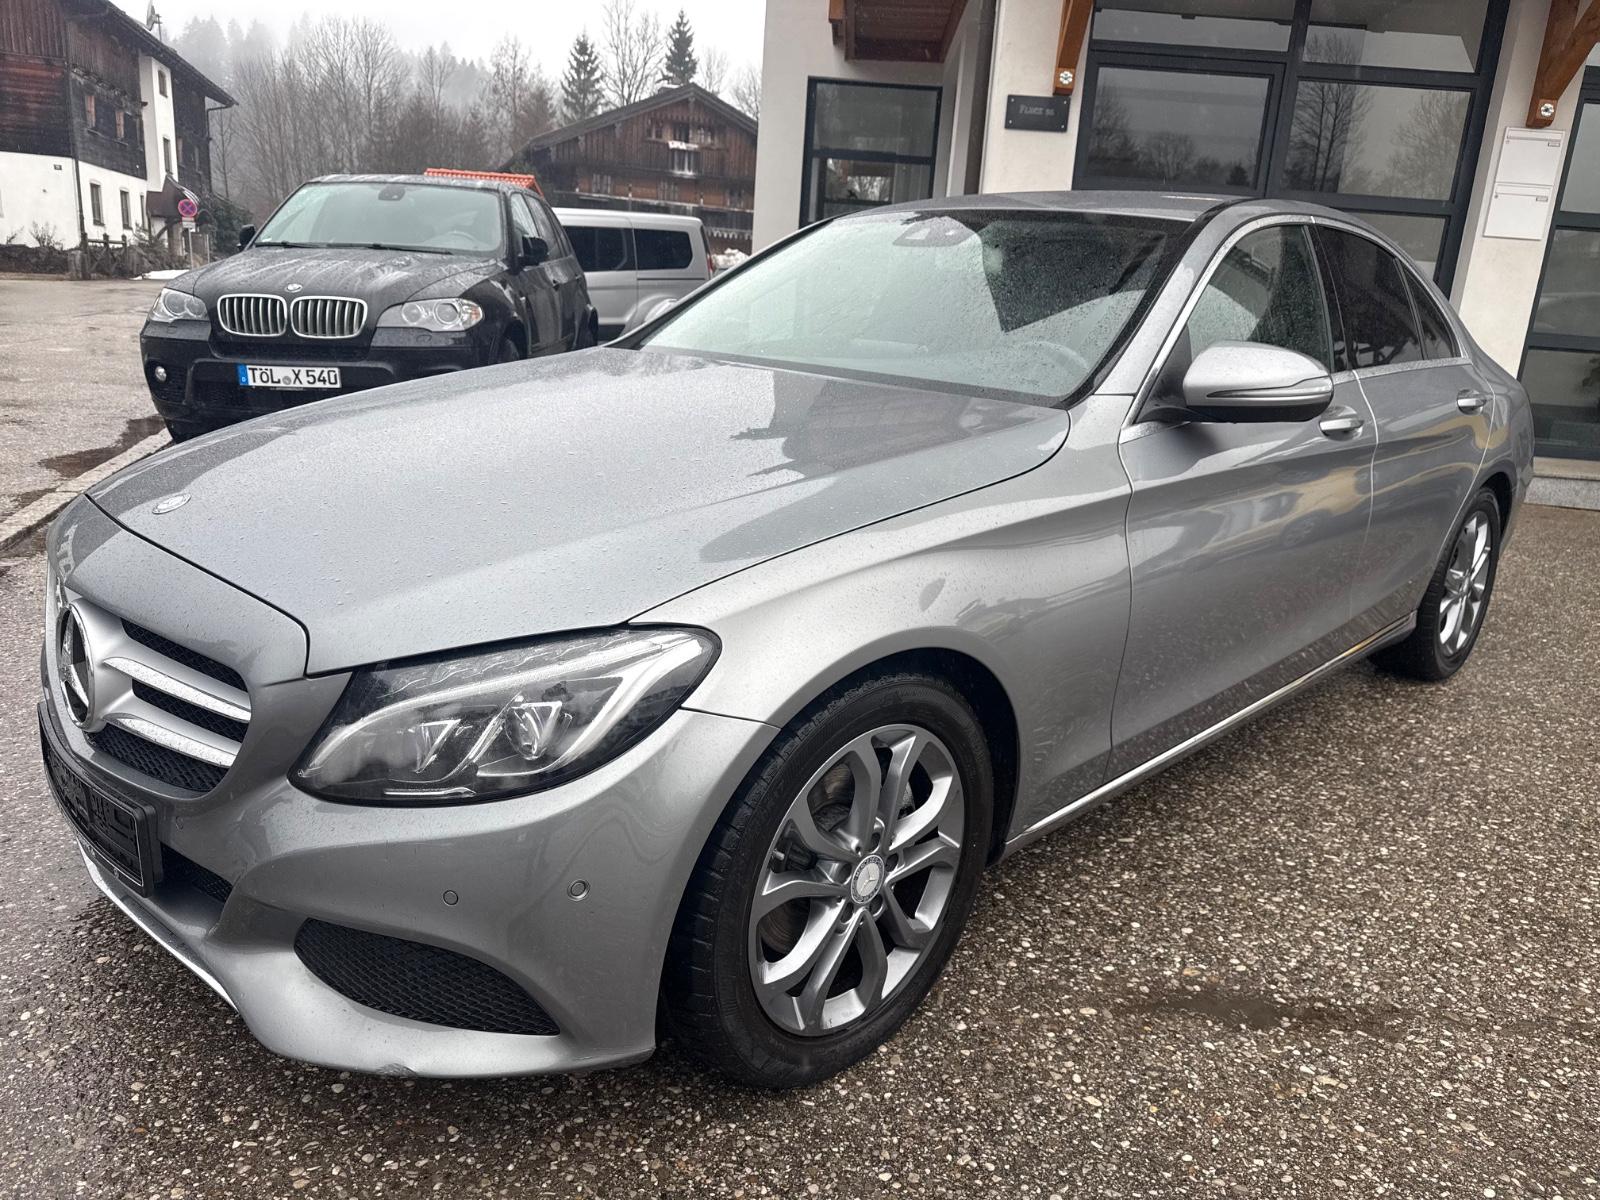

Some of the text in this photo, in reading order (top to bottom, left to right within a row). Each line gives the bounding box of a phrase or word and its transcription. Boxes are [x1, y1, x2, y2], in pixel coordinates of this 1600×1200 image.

[248, 367, 338, 385] TÖL X 540
